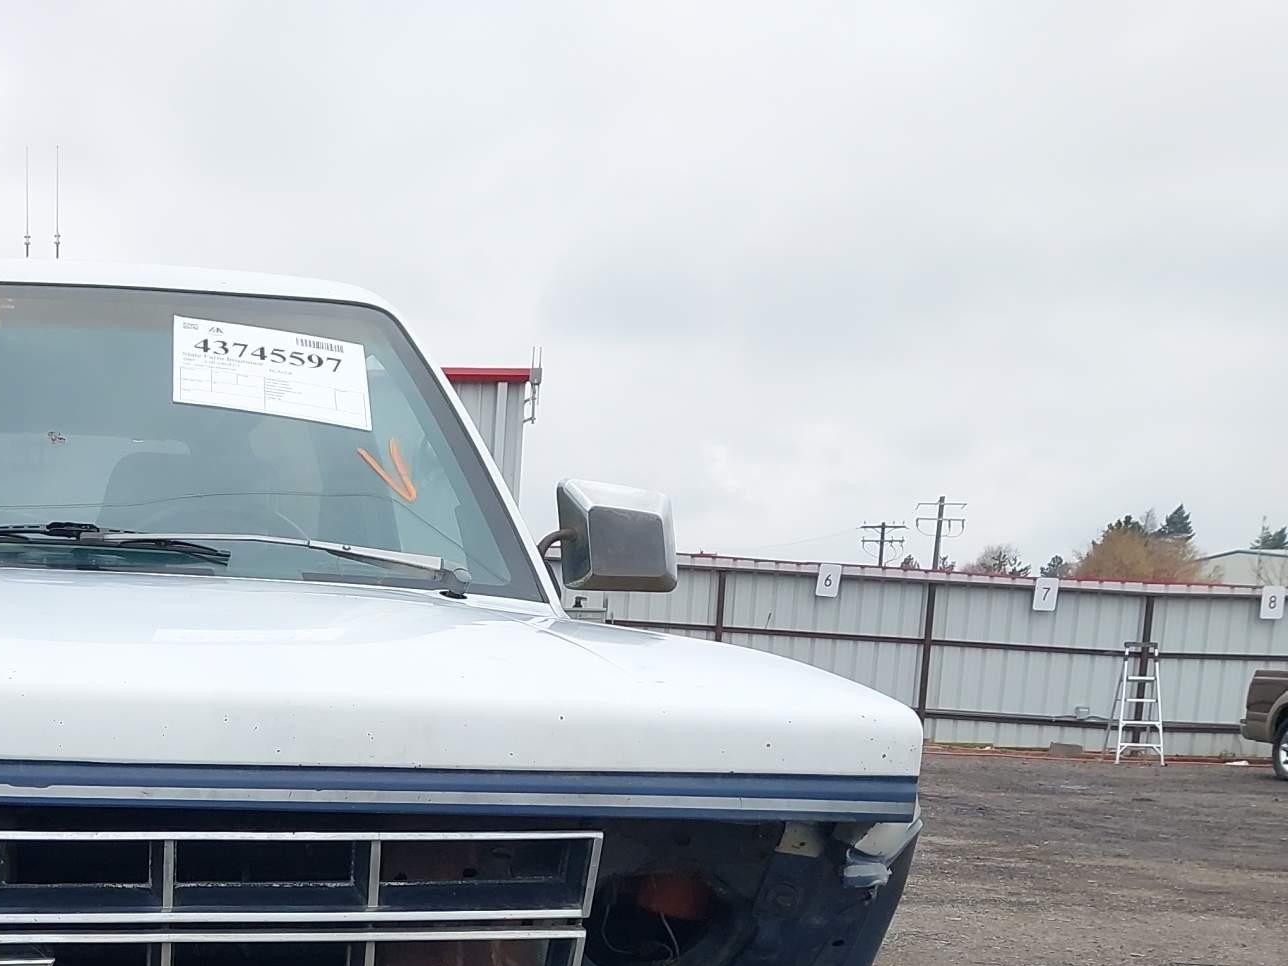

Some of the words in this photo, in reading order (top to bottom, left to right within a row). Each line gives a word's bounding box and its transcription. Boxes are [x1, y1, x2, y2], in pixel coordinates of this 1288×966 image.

[194, 338, 342, 372] 43745597
[824, 574, 832, 587] 6
[1042, 587, 1051, 601] 7
[1268, 595, 1277, 610] 8
